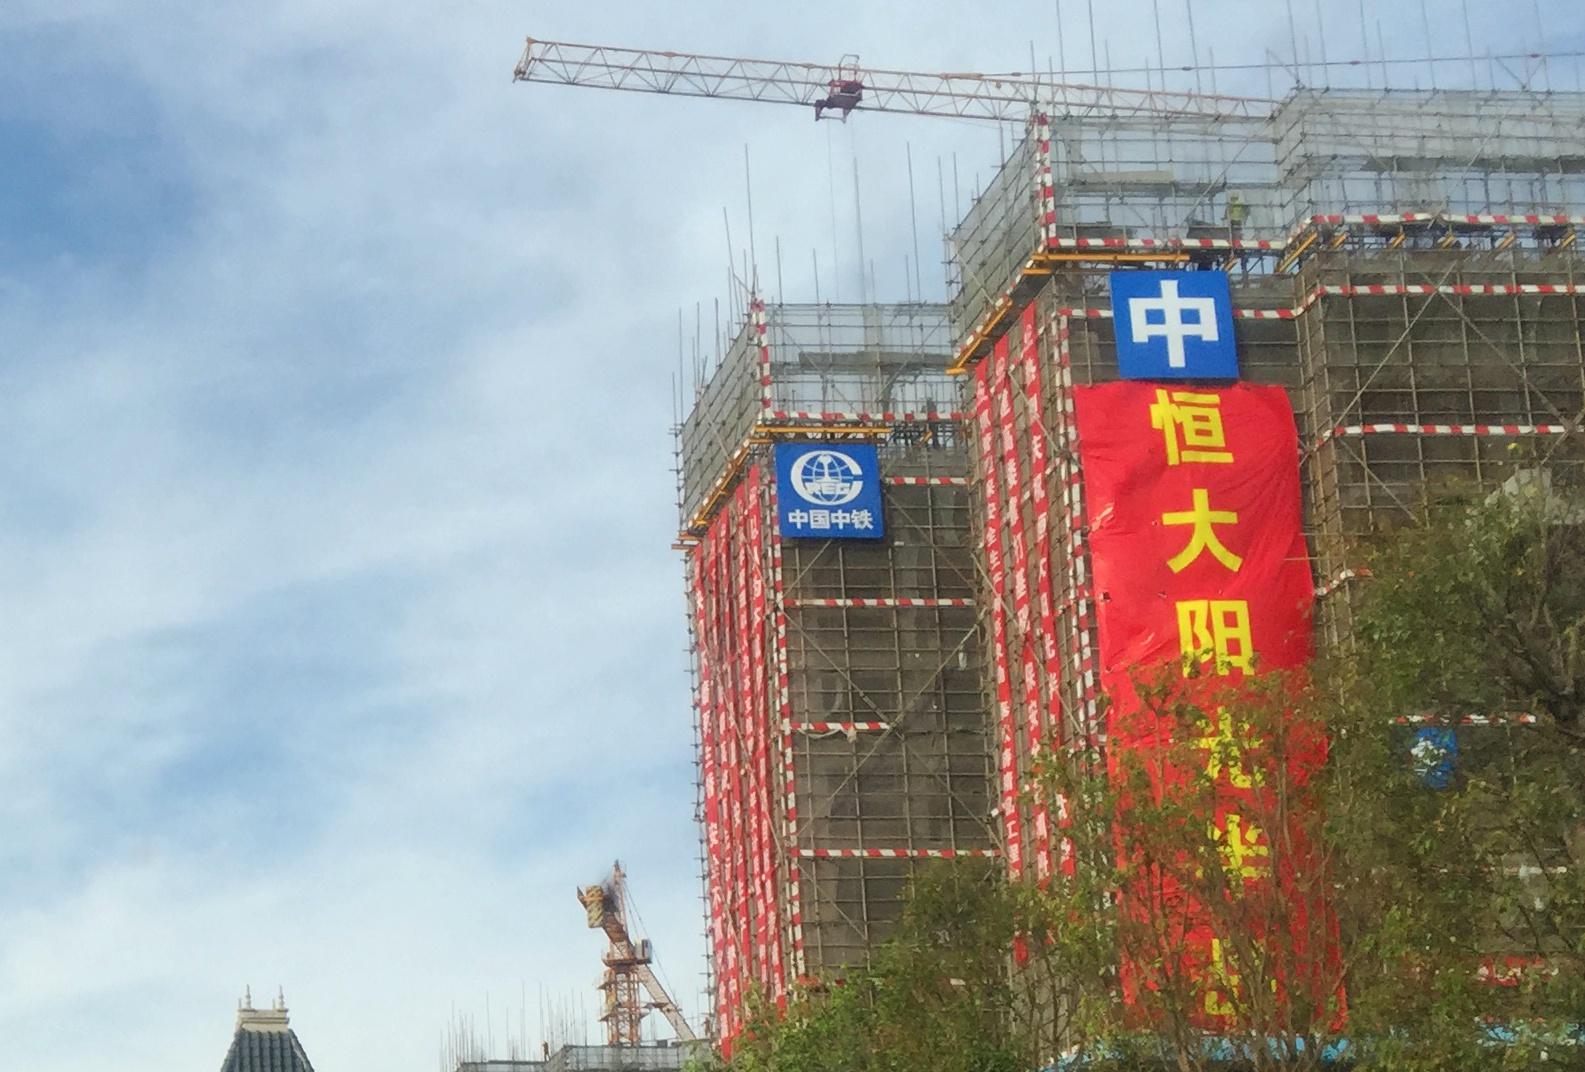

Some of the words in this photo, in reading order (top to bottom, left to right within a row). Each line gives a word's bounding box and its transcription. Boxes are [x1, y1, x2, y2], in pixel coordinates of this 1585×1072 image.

[1128, 279, 1219, 368] 中
[788, 508, 874, 530] 中国中铁
